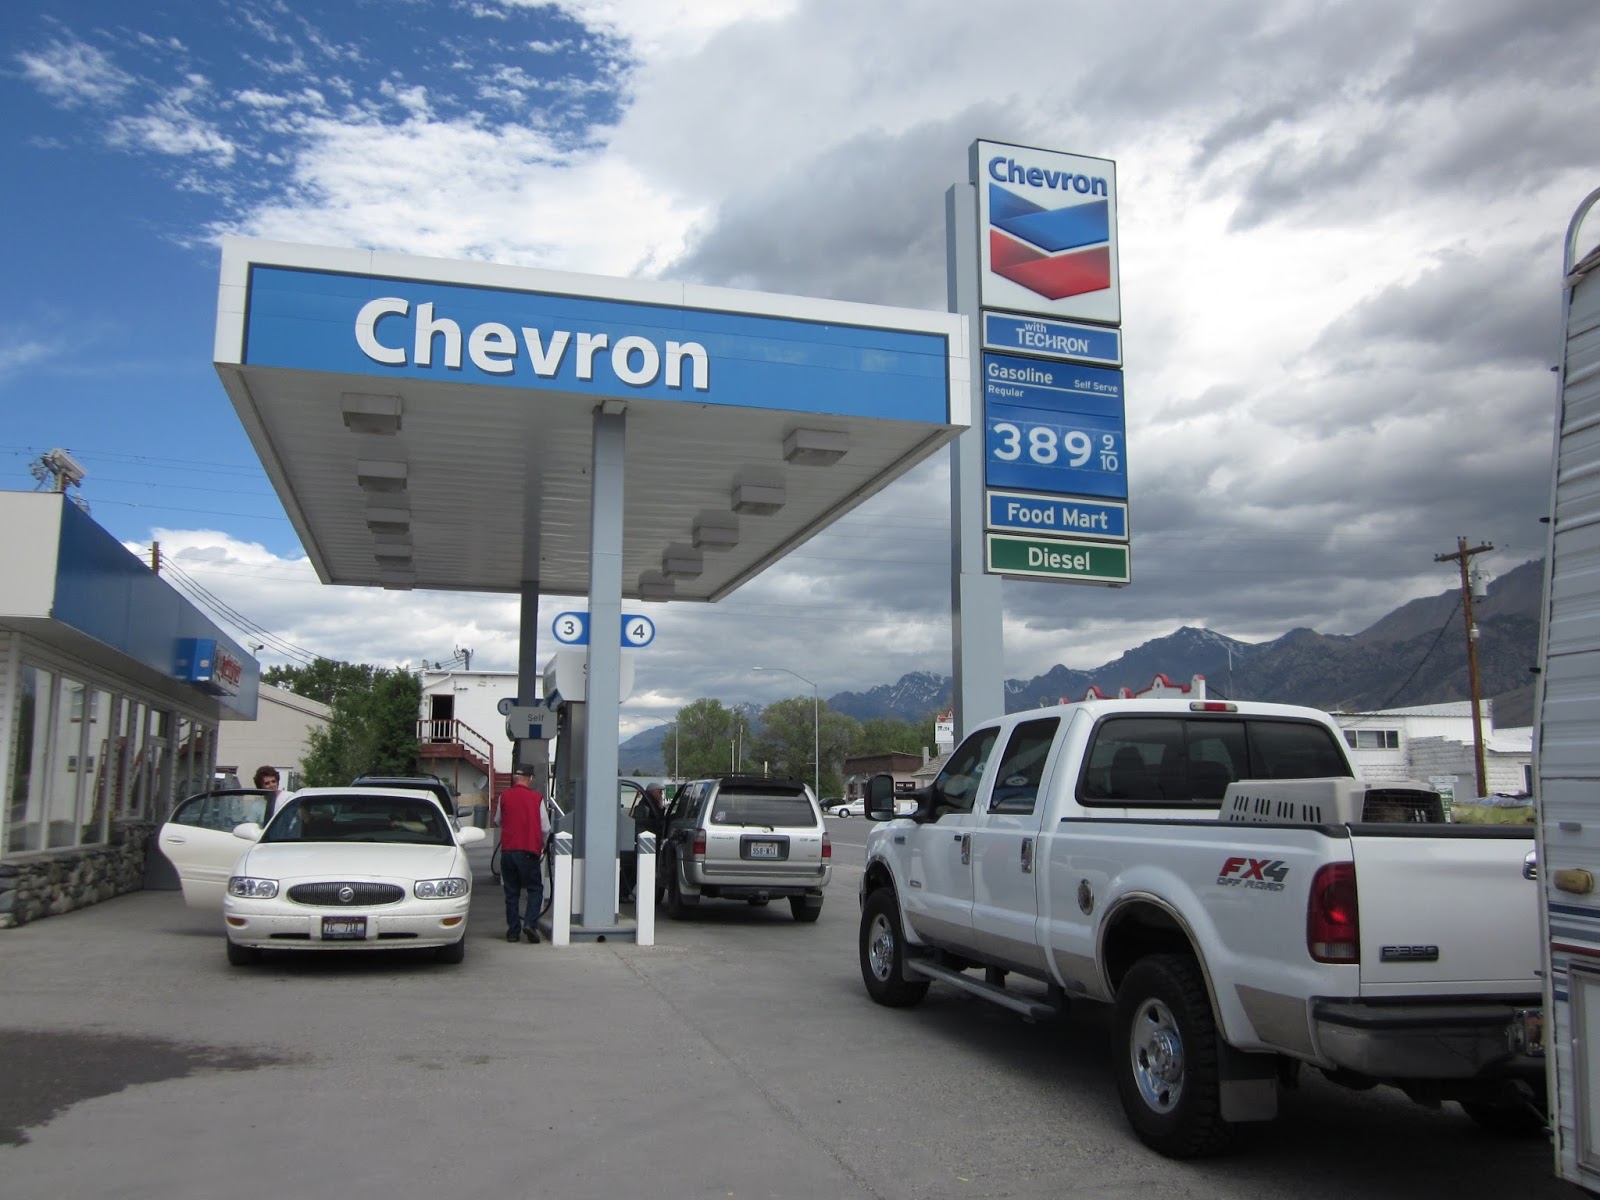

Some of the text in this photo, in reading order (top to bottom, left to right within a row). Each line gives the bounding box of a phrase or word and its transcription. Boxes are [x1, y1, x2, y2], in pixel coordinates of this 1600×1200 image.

[988, 156, 1108, 197] Chevron
[1024, 322, 1047, 333] with
[354, 297, 710, 390] Chevron
[1016, 328, 1089, 353] TECHRON
[988, 363, 1053, 384] Gasoline
[988, 385, 1025, 397] Regular
[1074, 380, 1118, 393] Self Serve
[993, 422, 1092, 467] 389
[1102, 434, 1115, 450] 9
[1100, 455, 1119, 472] 10
[1008, 502, 1108, 530] Food Mart
[1028, 546, 1091, 571] Diesel
[563, 620, 575, 636] 3
[632, 623, 645, 639] 4
[527, 713, 545, 722] Self
[1218, 857, 1290, 883] FX4
[1216, 876, 1286, 892] OFF ROAD
